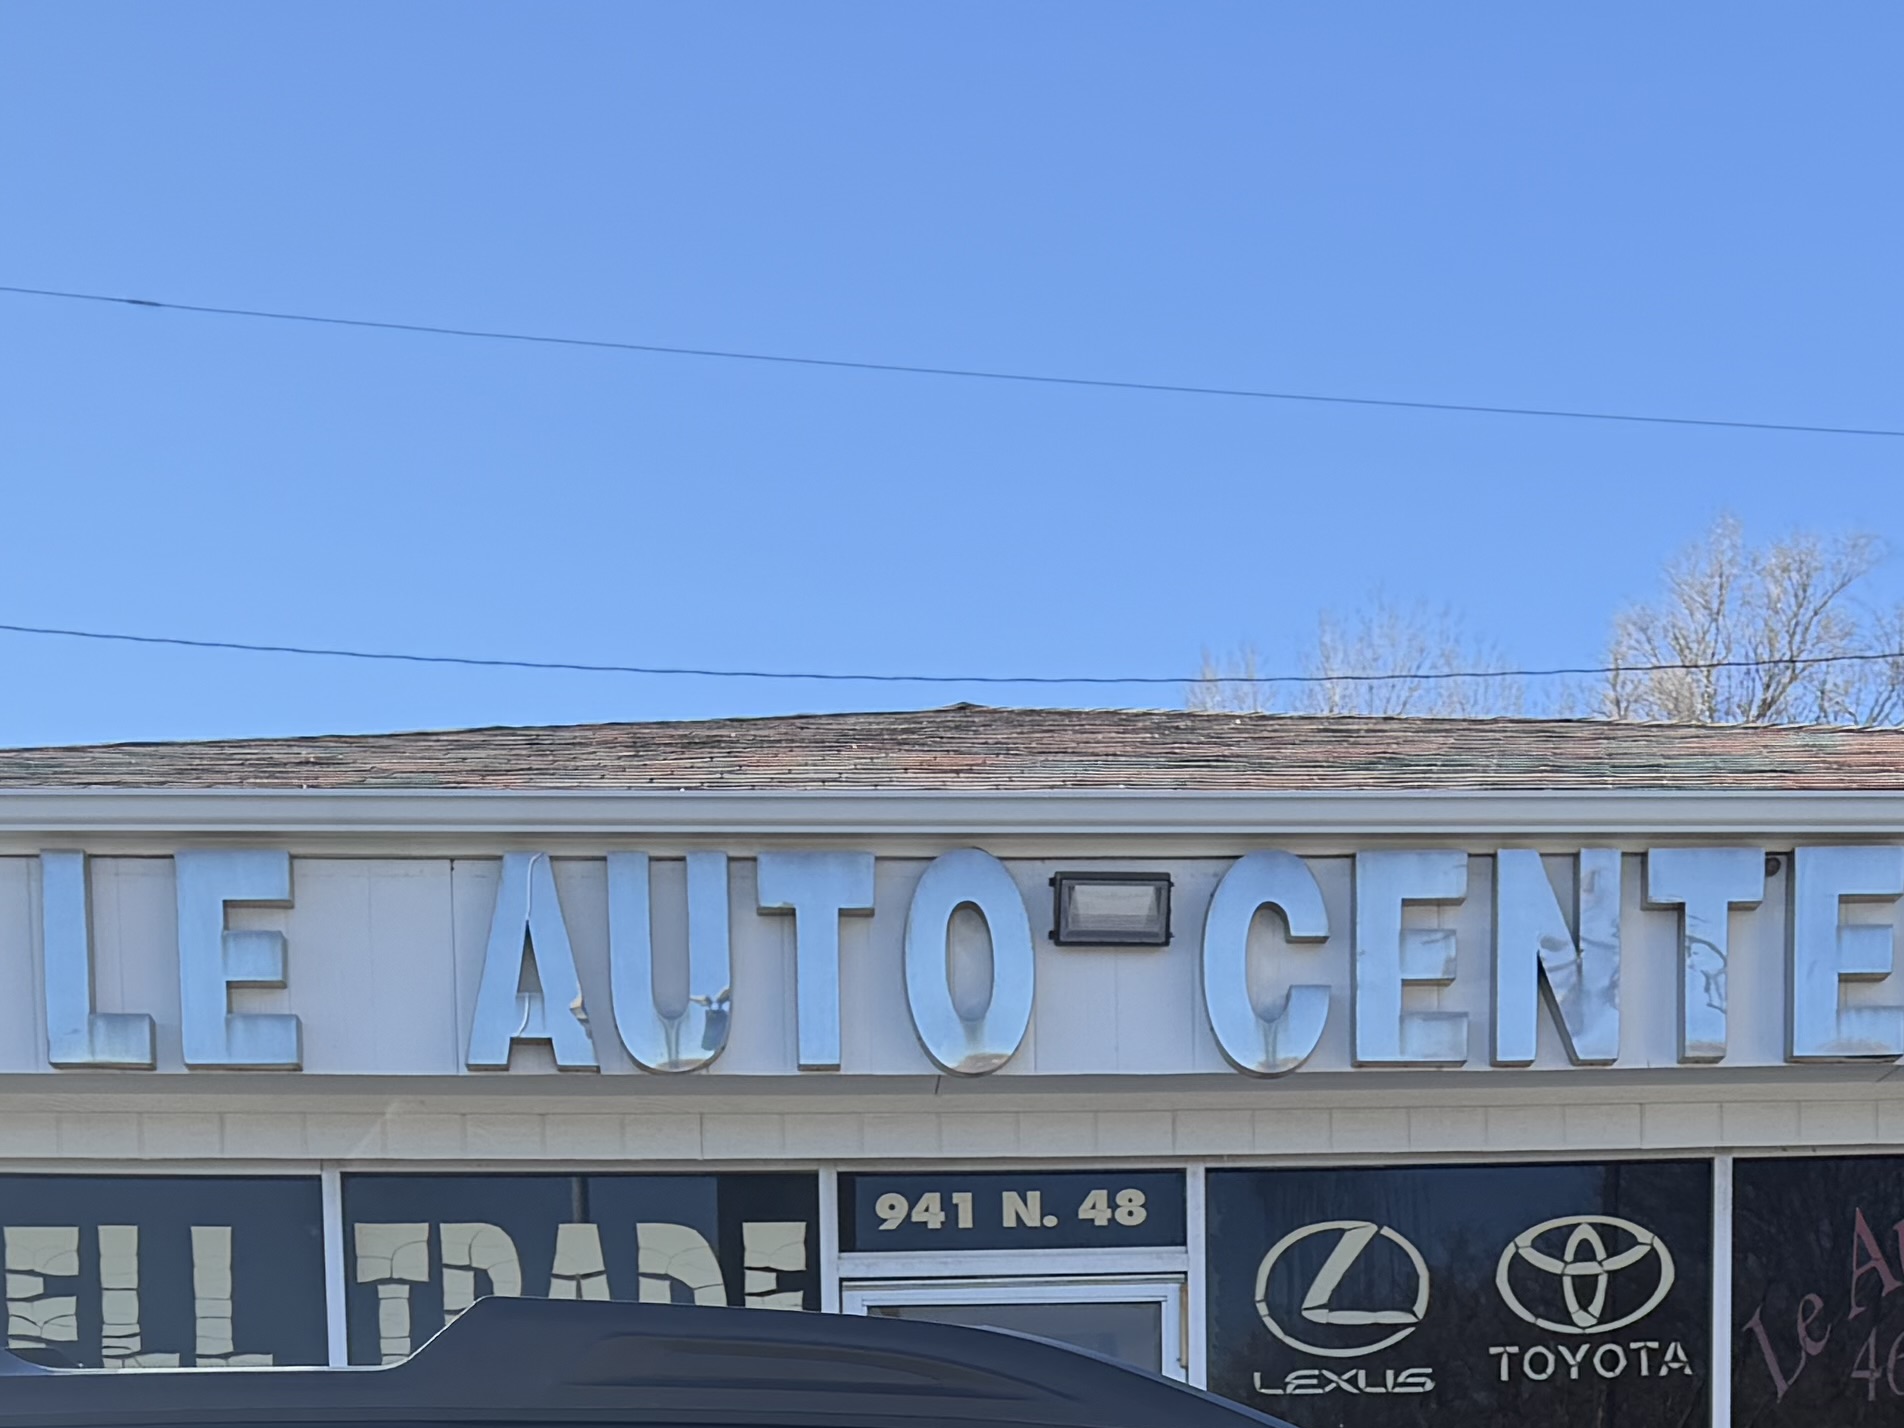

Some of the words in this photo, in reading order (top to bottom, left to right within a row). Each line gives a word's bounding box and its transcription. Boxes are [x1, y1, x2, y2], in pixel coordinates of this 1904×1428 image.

[39, 848, 302, 1072] LE
[465, 845, 1036, 1078] AUTO
[874, 1192, 974, 1230] 941
[1001, 1190, 1059, 1228] N.
[1077, 1187, 1147, 1226] 48
[1488, 1340, 1694, 1382] TOYOTA
[1740, 1291, 1834, 1405] Le
[1252, 1366, 1436, 1396] LEXUS
